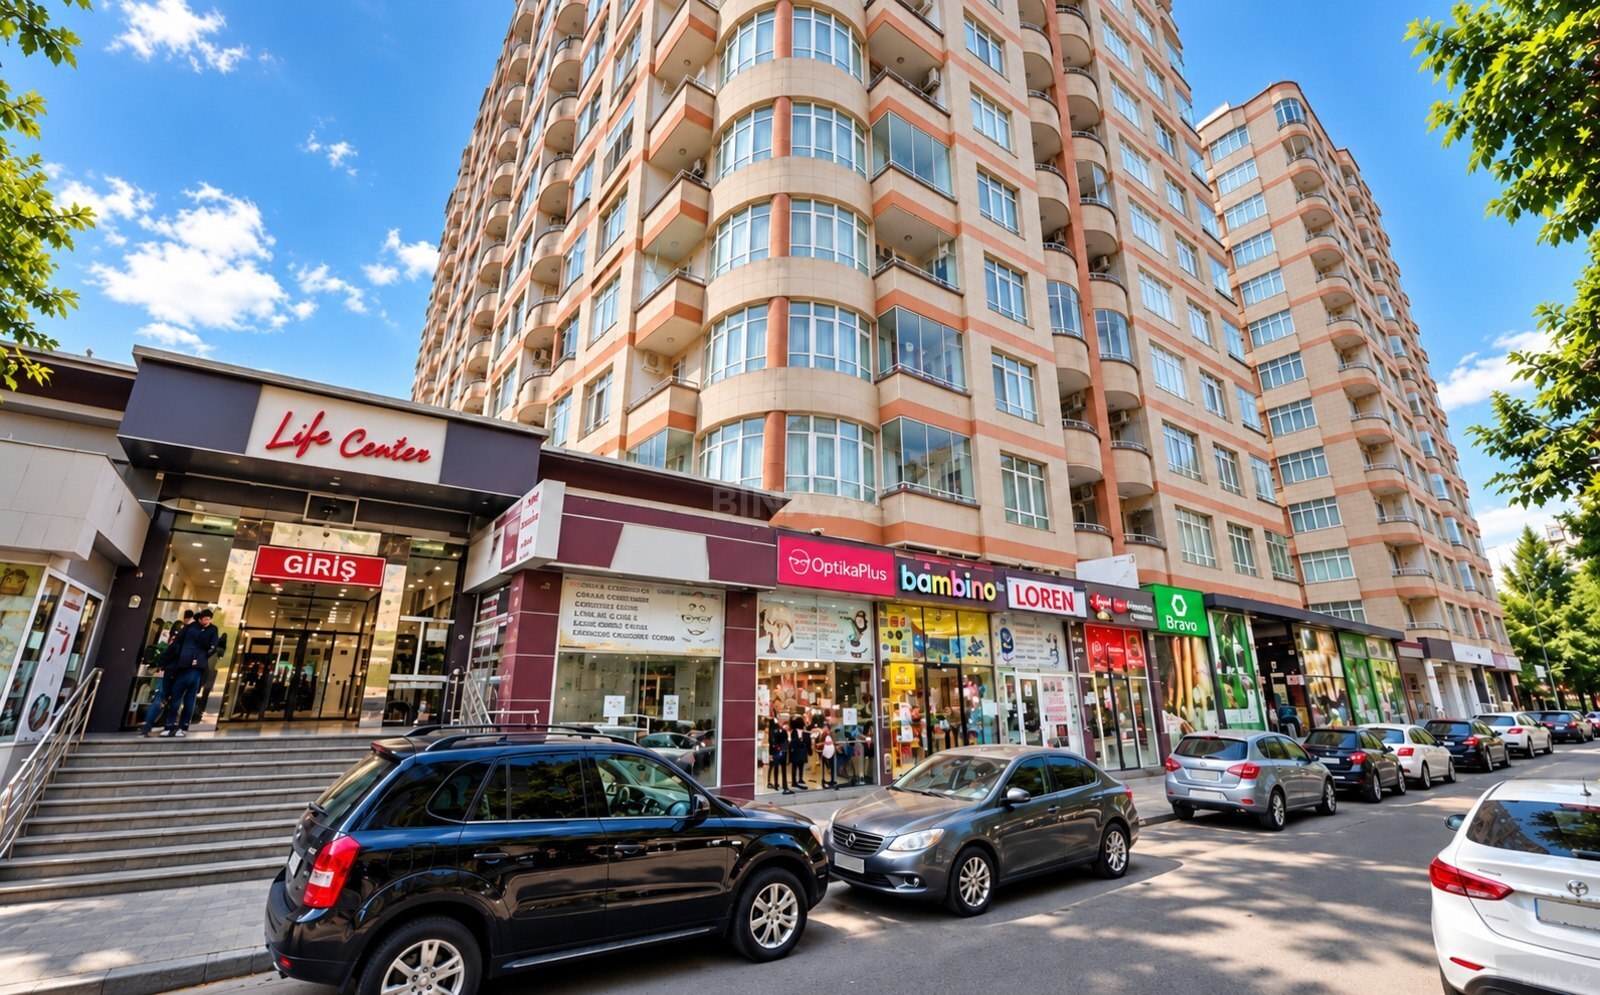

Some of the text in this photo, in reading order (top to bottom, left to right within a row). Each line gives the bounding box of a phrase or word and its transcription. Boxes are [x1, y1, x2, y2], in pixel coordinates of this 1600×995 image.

[265, 410, 431, 463] Life Center
[284, 553, 357, 582] GİRİŞ
[811, 557, 887, 581] OptikaPlus
[901, 563, 996, 602] bambino
[1015, 584, 1075, 613] LOREN
[1165, 614, 1198, 632] Bravo
